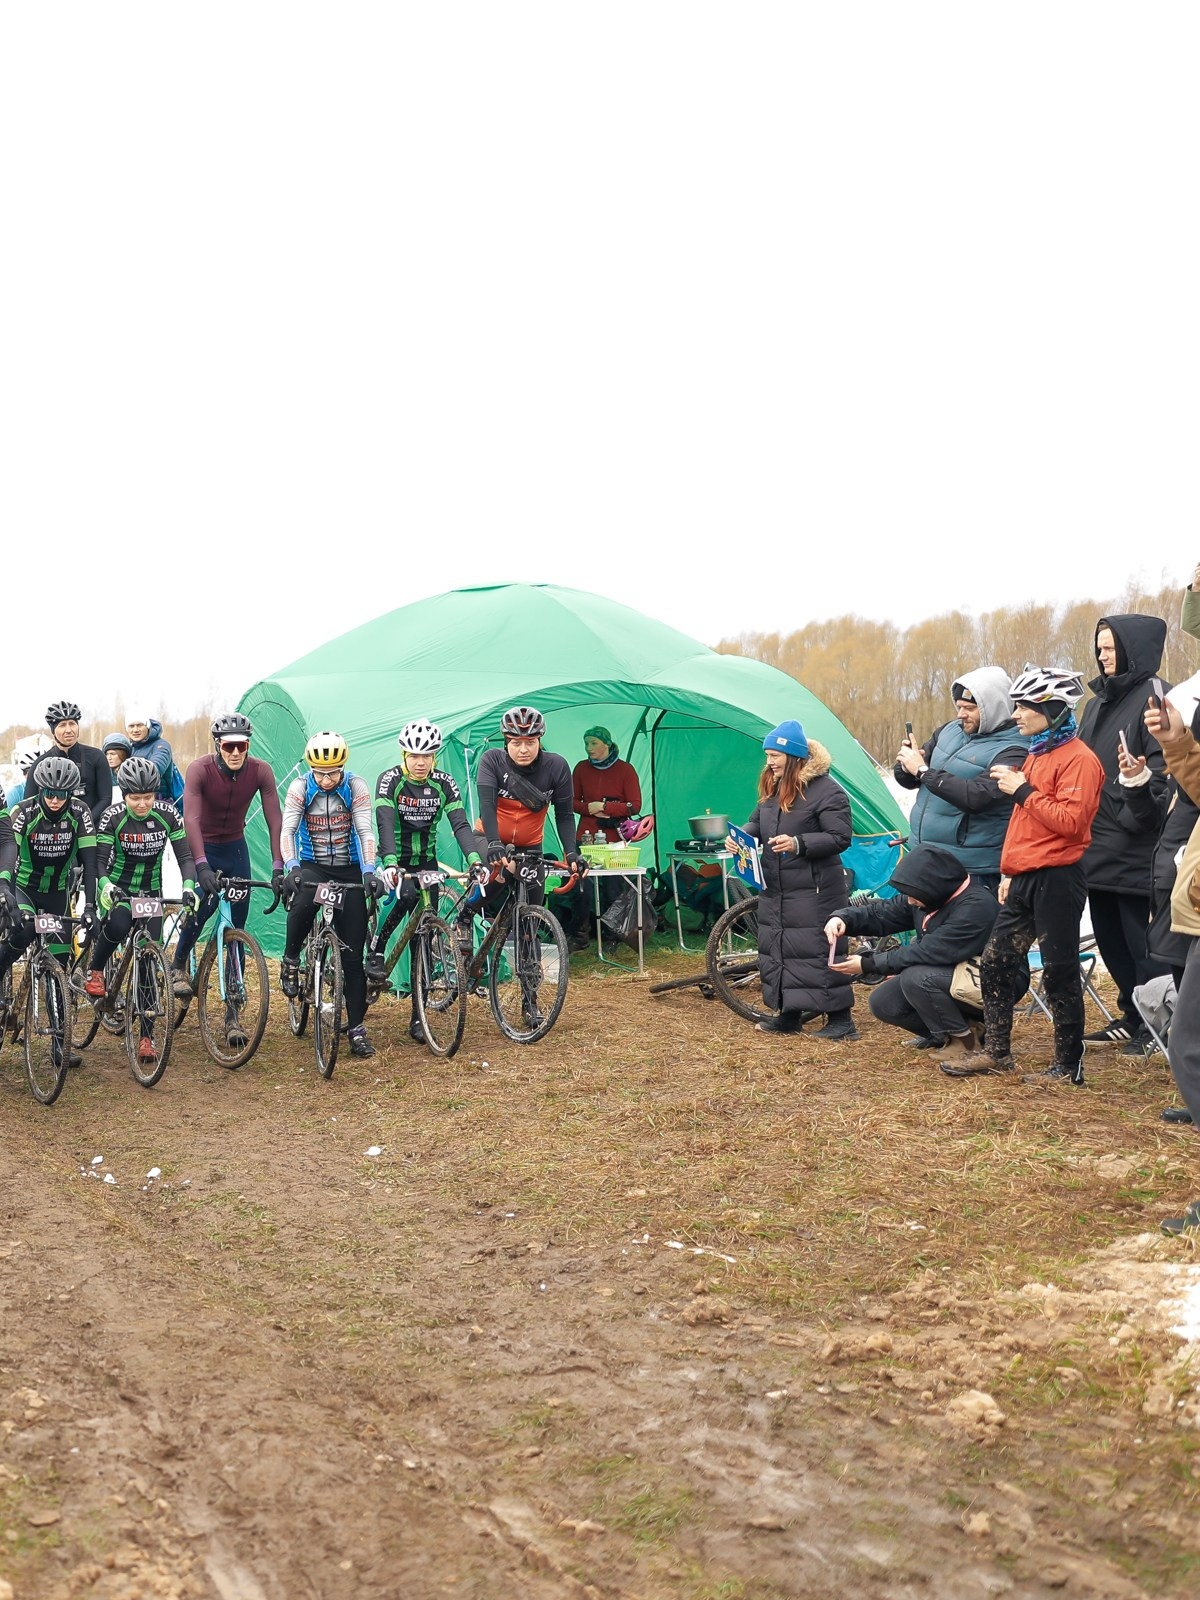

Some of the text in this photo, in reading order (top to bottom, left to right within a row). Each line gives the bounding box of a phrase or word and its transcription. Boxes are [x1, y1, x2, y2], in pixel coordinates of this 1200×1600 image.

[33, 844, 71, 852] KORENKOV
[227, 887, 248, 900] 037
[320, 887, 342, 904] 061
[135, 902, 159, 913] 067
[39, 918, 63, 929] 056
